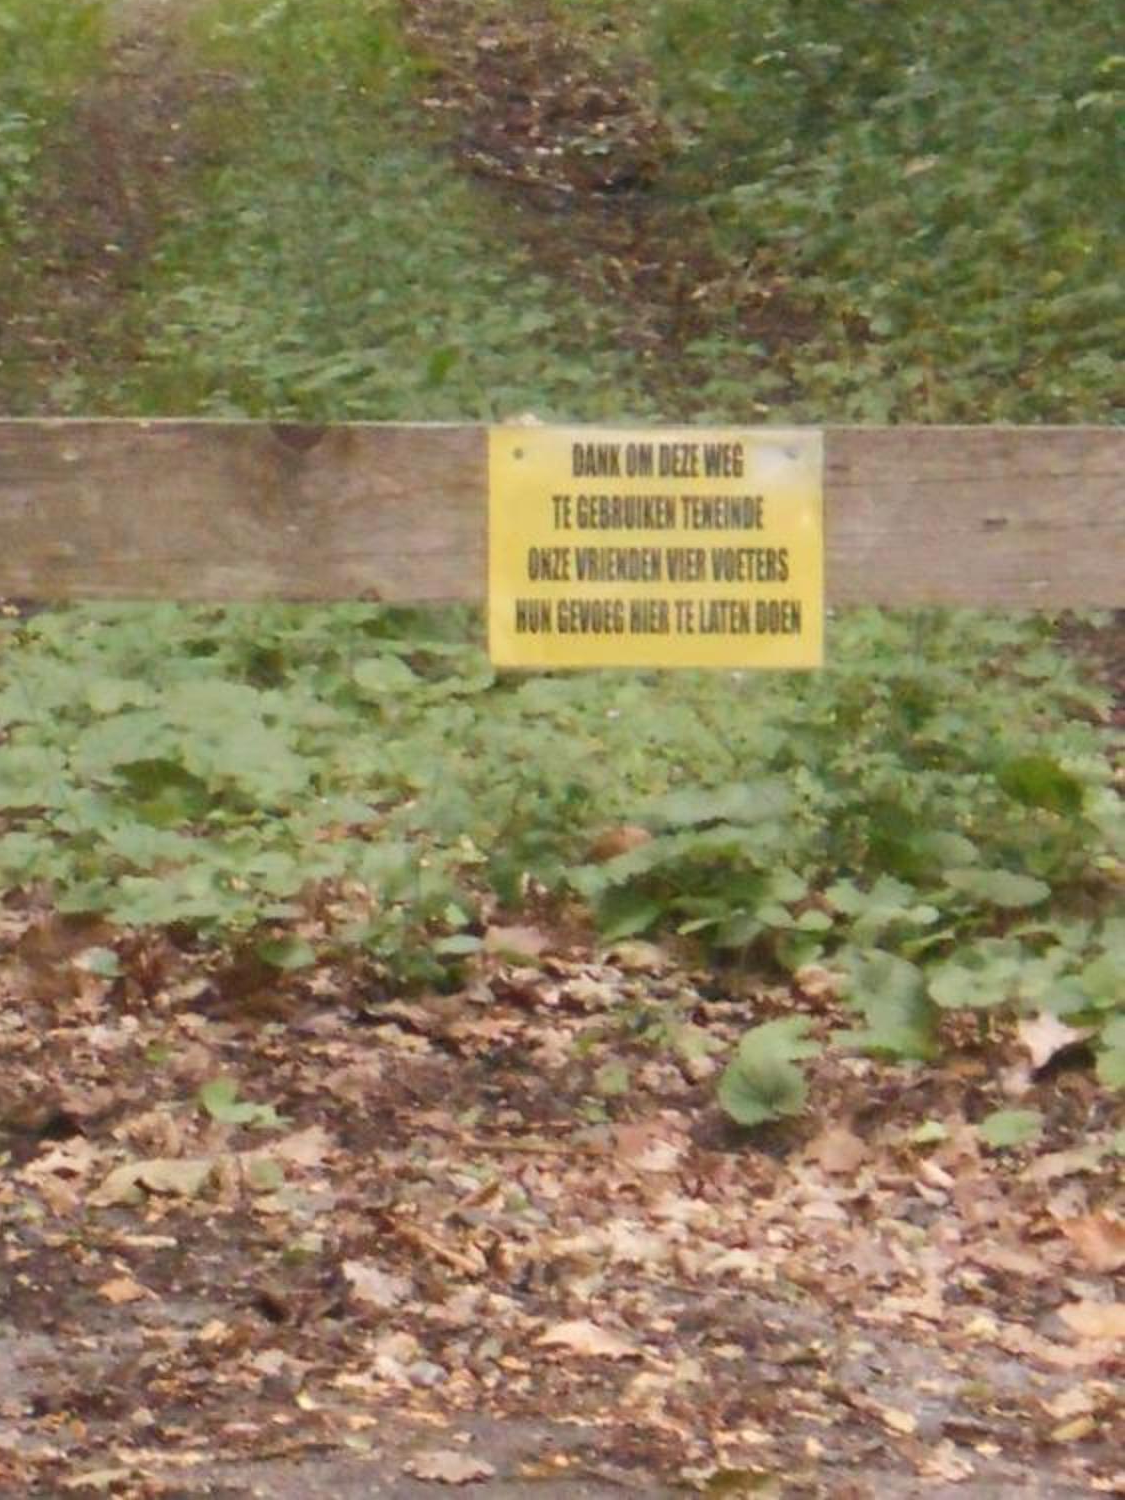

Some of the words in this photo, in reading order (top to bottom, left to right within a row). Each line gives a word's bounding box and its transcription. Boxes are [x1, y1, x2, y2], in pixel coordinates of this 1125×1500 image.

[573, 443, 620, 477] DANK
[626, 443, 653, 477] OM
[659, 443, 699, 477] DEZE
[704, 443, 743, 477] WEG
[552, 496, 571, 529] TE
[577, 496, 675, 530] GEBRUIKEN
[681, 496, 763, 530] TENEINDE
[528, 547, 570, 580] ONZE
[575, 547, 661, 581] VRIENDEN
[667, 547, 707, 582] VIER
[711, 547, 788, 582] VOETERS
[515, 599, 552, 634] HUN
[557, 599, 624, 635] GEVOEG
[630, 600, 669, 635] HIER
[675, 600, 693, 635] TE
[699, 600, 750, 635] LATEN
[756, 600, 801, 635] DOEN
